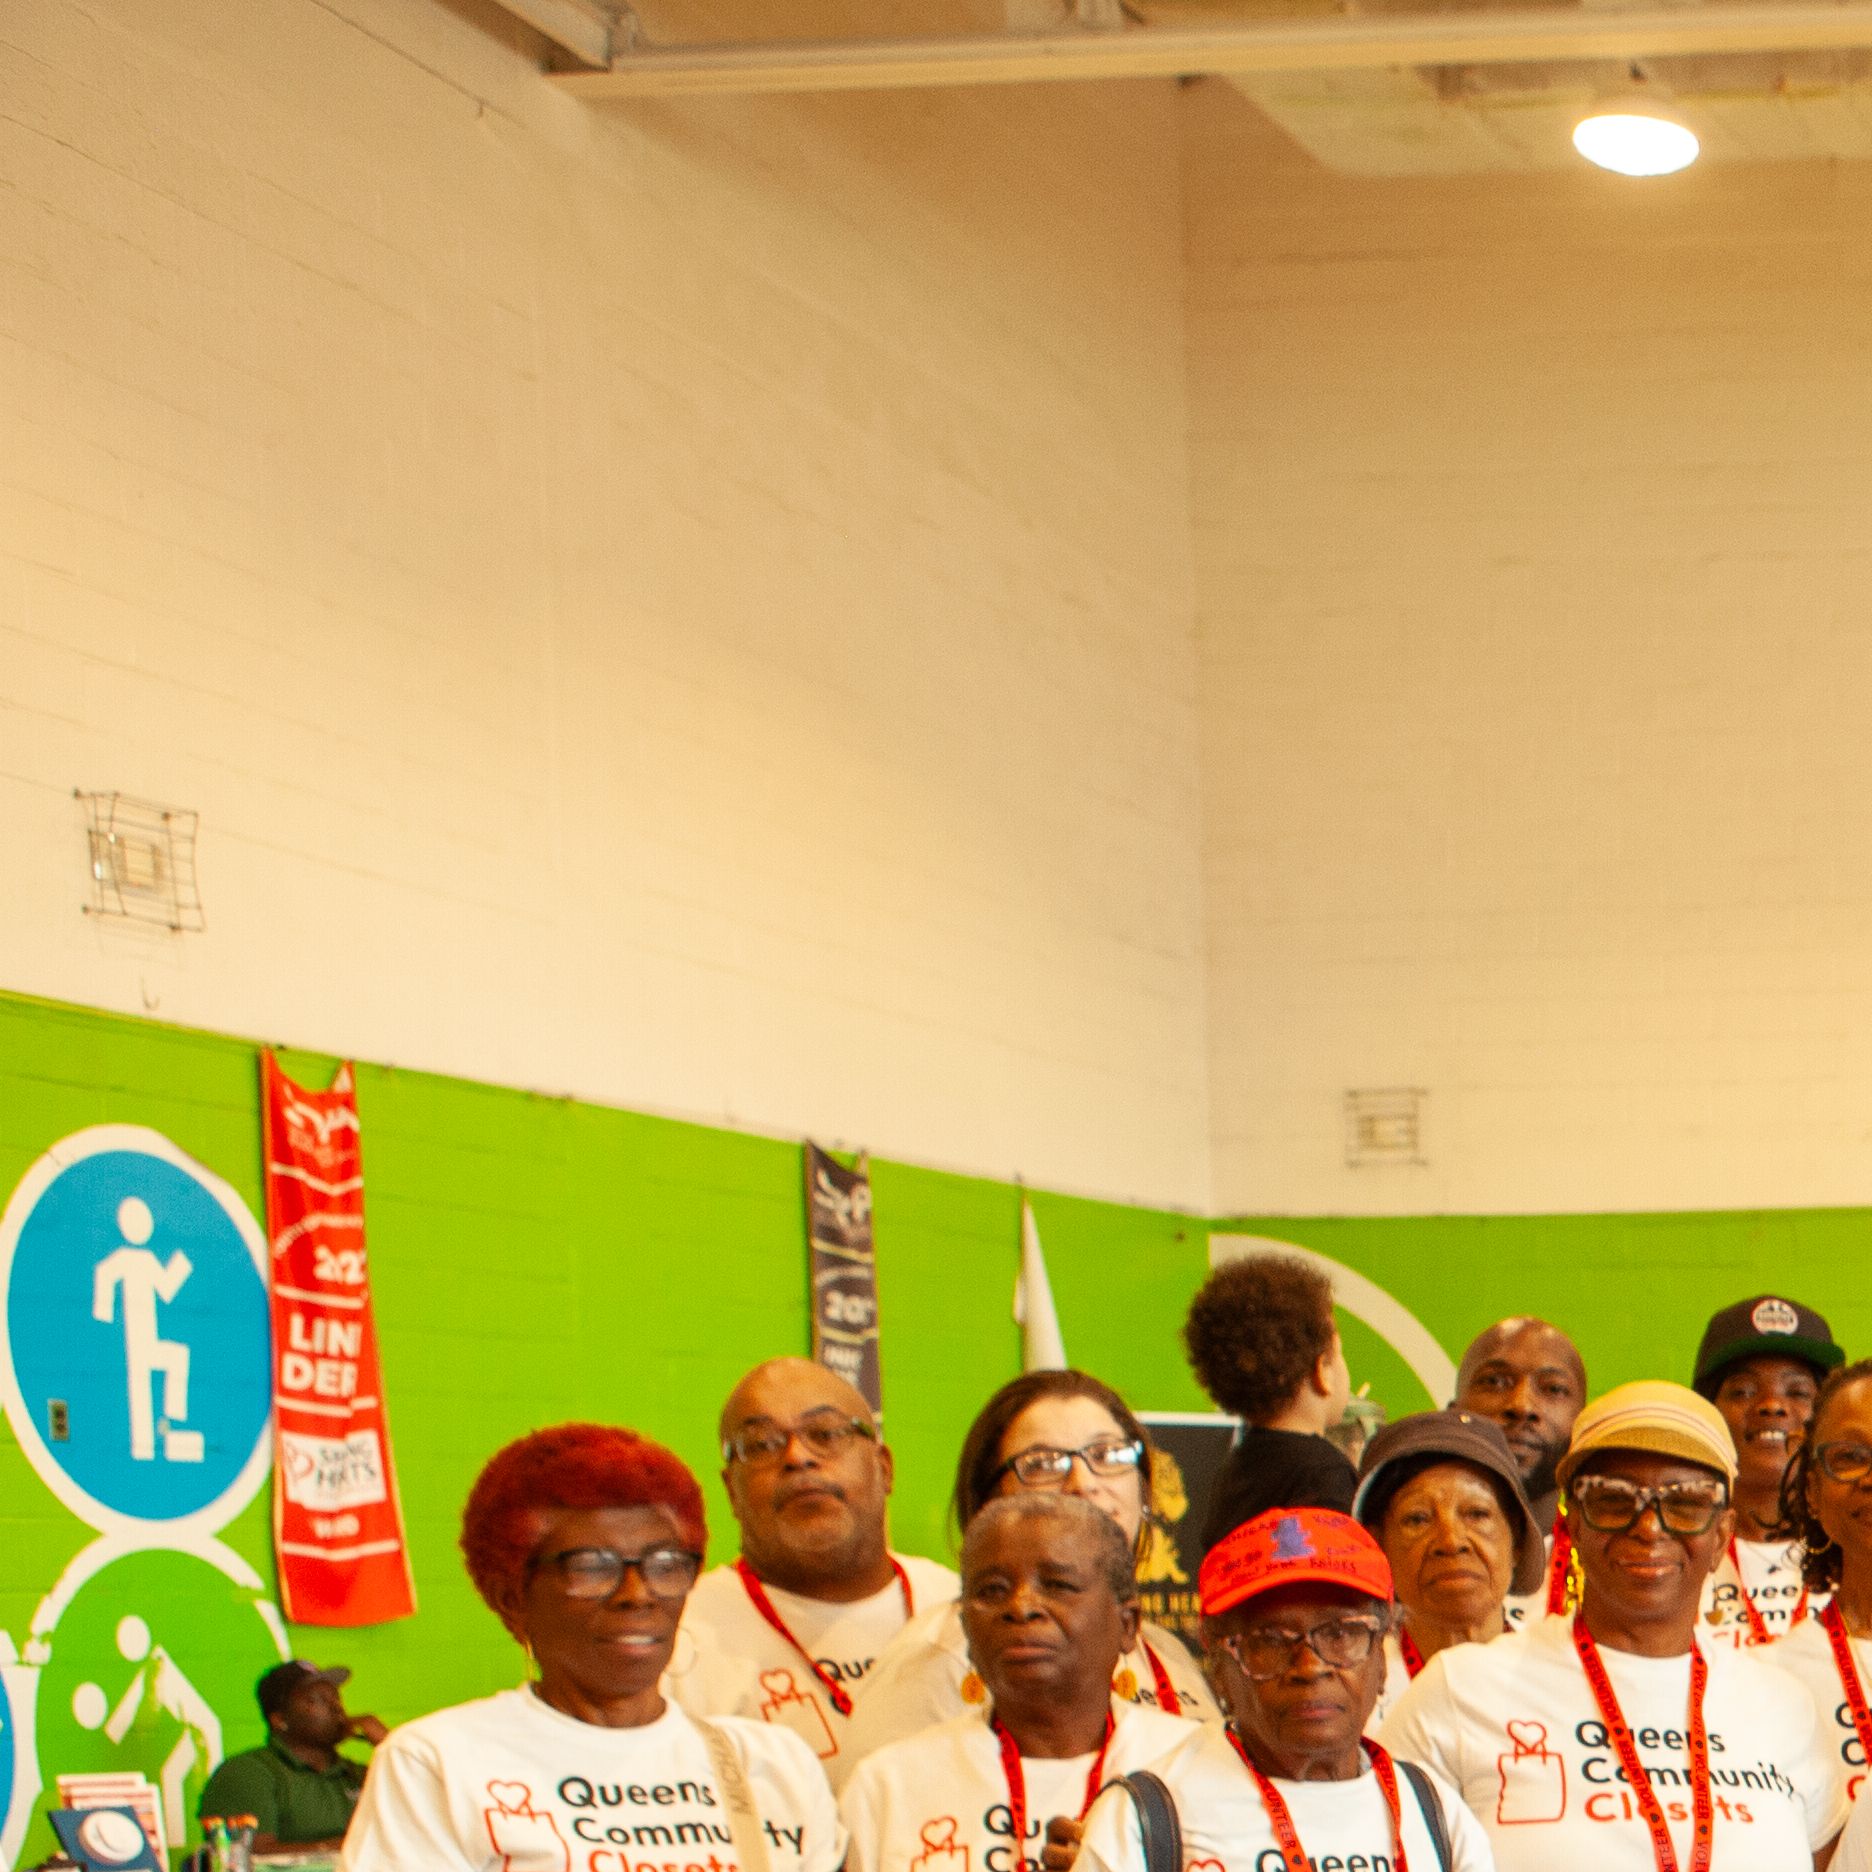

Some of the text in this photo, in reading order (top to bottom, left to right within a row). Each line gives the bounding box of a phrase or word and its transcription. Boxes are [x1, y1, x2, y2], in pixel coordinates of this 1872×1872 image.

[1575, 1720, 1726, 1754] Qees
[558, 1776, 717, 1808] Queens
[572, 1817, 803, 1855] Commuty
